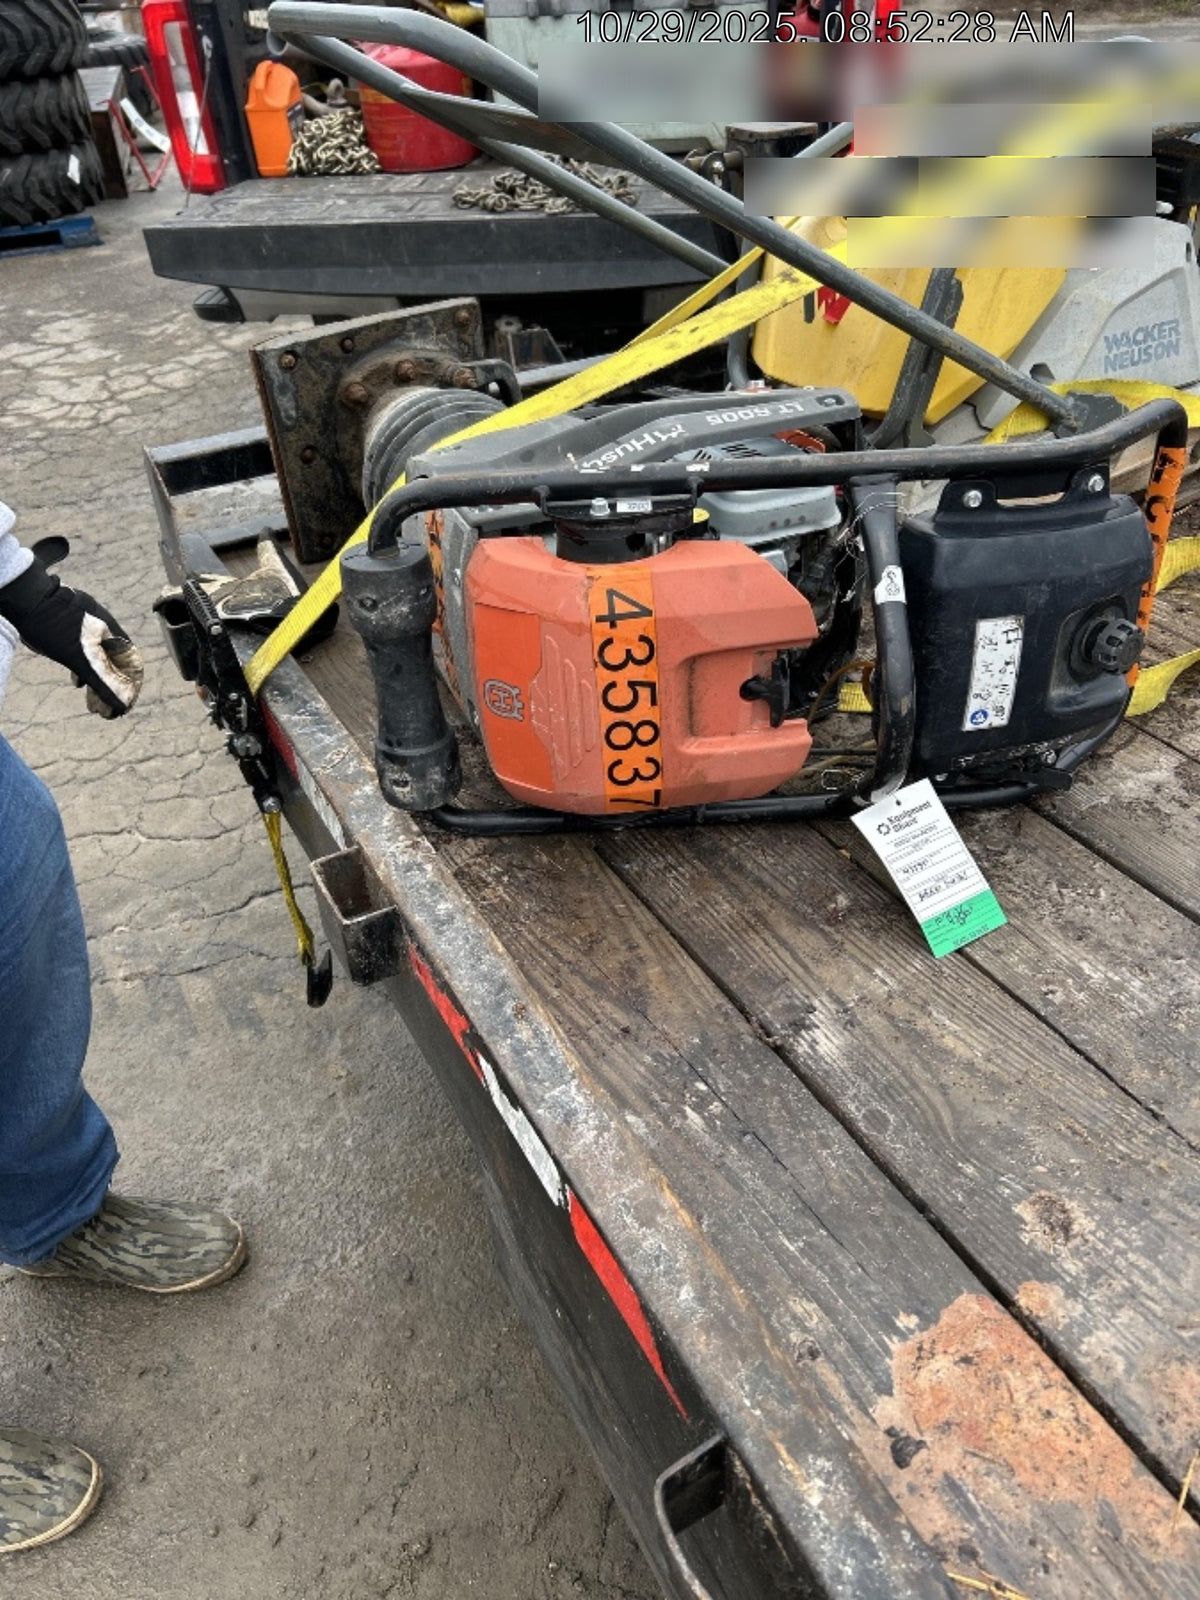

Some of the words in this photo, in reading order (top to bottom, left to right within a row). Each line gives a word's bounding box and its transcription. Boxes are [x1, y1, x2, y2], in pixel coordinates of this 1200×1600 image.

[1103, 319, 1181, 354] WACKER
[1104, 338, 1180, 374] NEUSON
[595, 588, 662, 807] 435837
